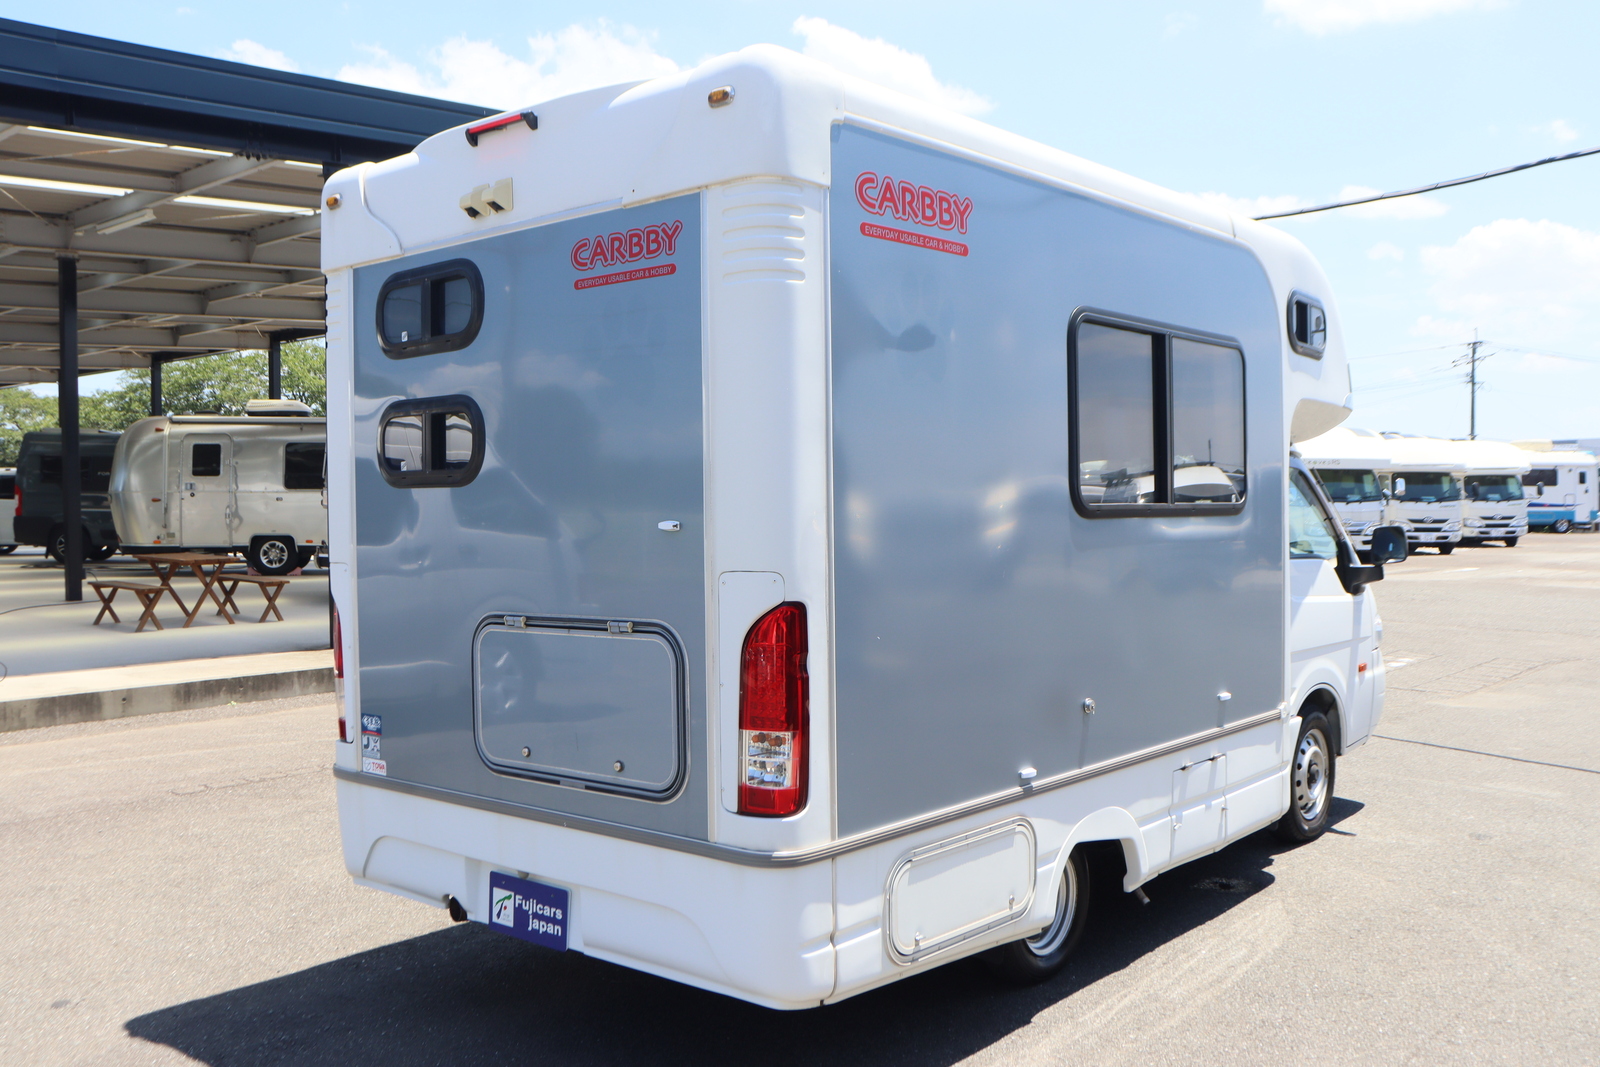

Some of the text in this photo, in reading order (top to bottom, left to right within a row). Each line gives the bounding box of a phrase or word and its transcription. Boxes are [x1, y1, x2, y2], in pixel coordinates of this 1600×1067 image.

[855, 171, 973, 235] CARBBY
[571, 219, 683, 271] CARBBY
[865, 225, 899, 240] EVERYDAY
[899, 232, 924, 246] USABLE
[925, 238, 938, 248] CAR
[944, 242, 965, 254] HOBBY
[577, 277, 607, 289] EVERYDAY
[608, 273, 631, 283] USABLE
[631, 271, 643, 279] CAR
[650, 265, 672, 275] HOBBY
[515, 894, 563, 920] Fujicars
[527, 914, 562, 937] japan
